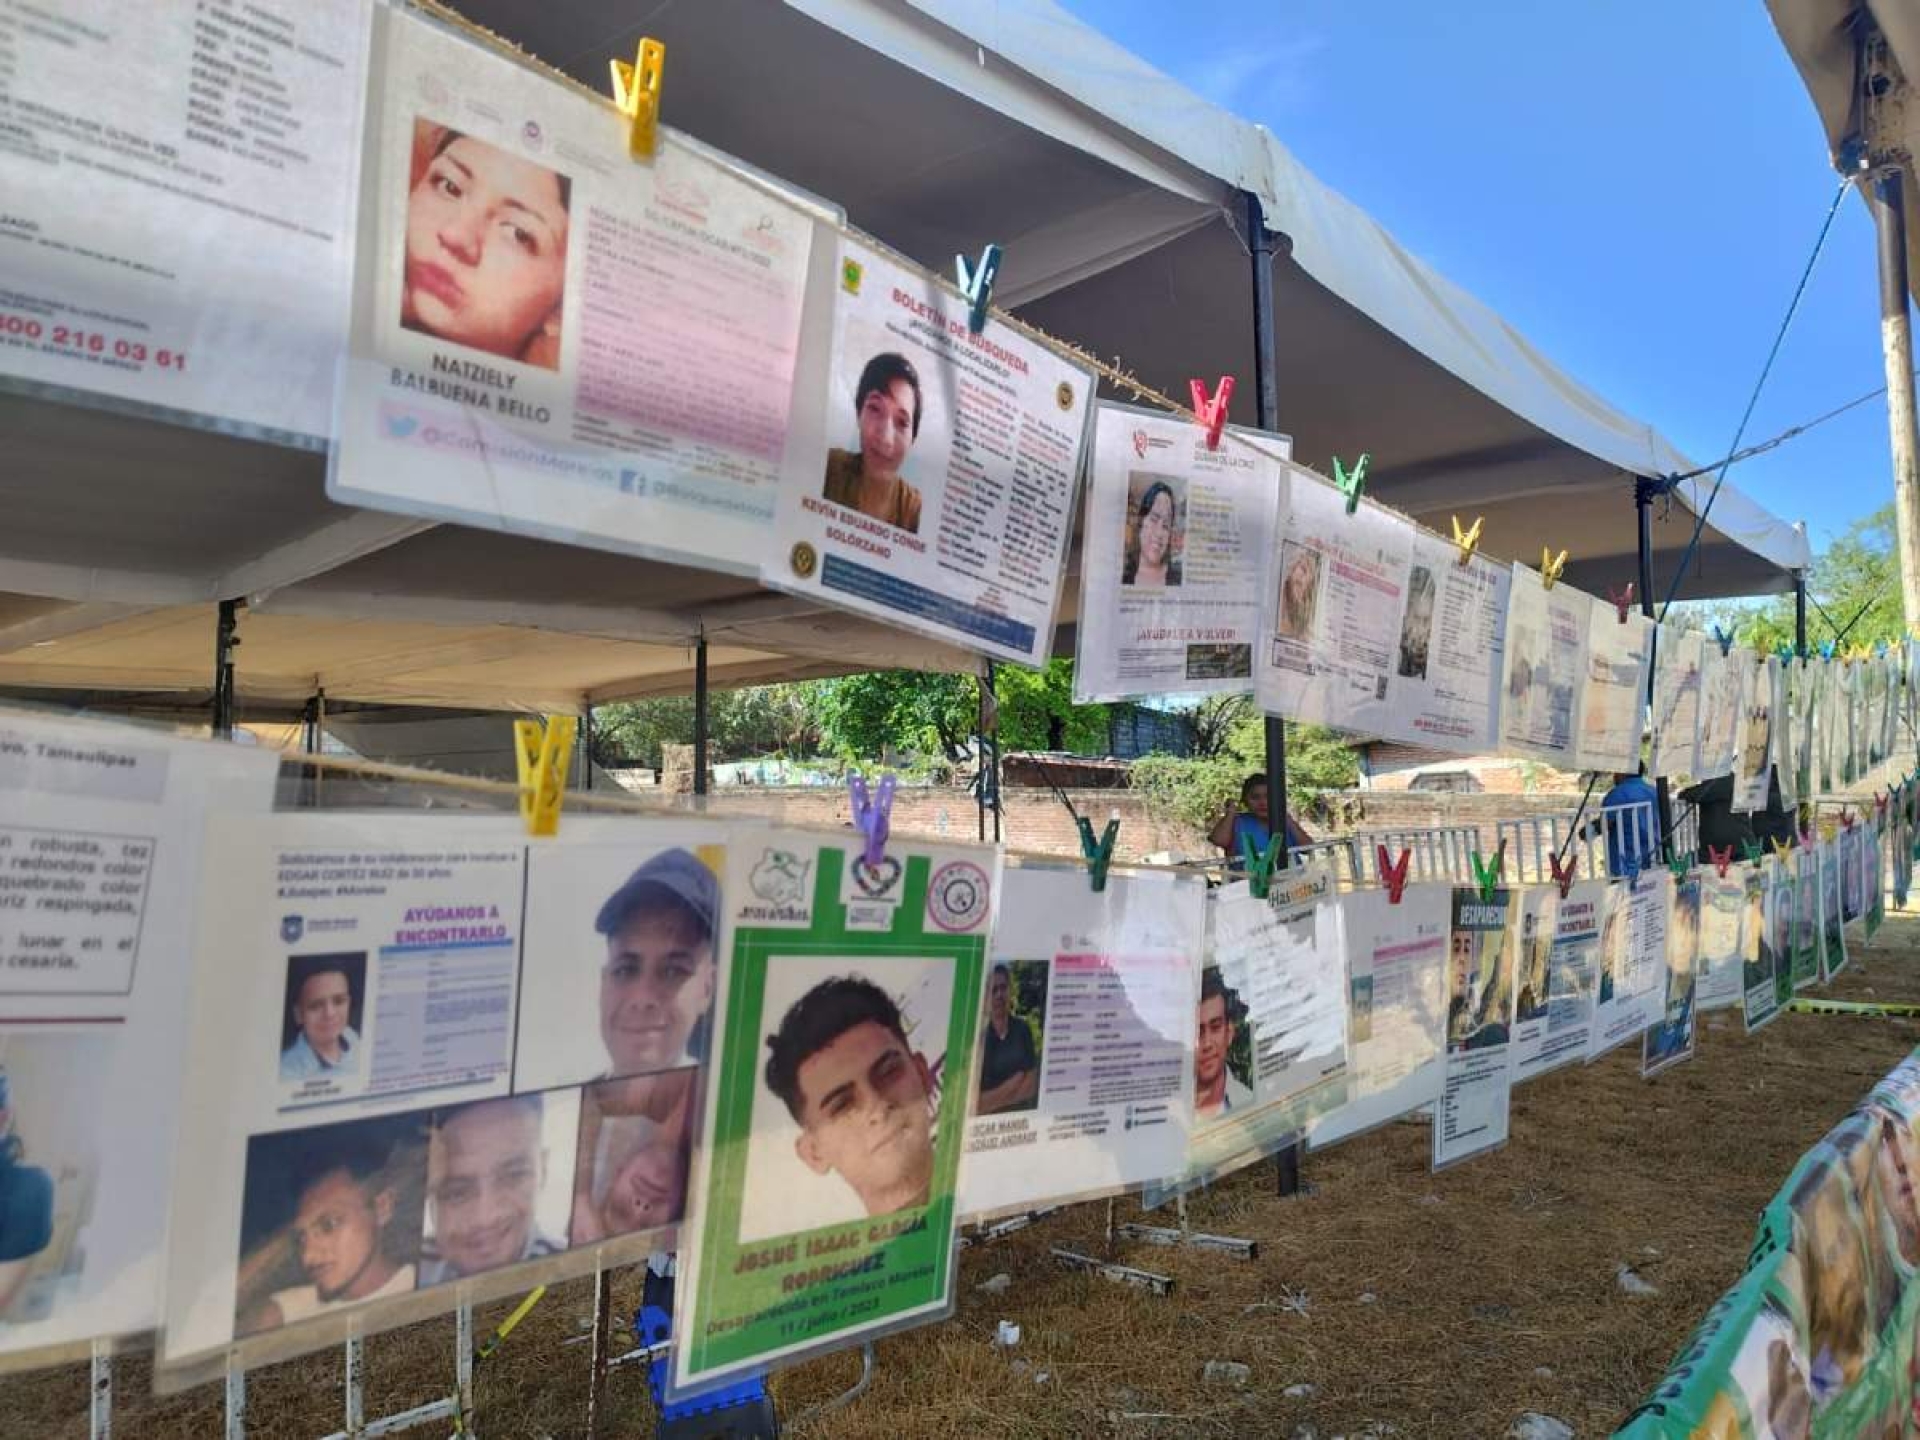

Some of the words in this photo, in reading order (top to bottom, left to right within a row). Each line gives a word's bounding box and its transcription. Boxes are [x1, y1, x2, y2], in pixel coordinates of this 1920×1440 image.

[949, 320, 966, 338] DE
[53, 325, 104, 353] 216
[114, 340, 147, 361] 03
[156, 349, 186, 371] 61
[431, 352, 516, 391] NATZIELY
[390, 367, 492, 411] BALBUENA
[497, 396, 551, 424] BELLO
[840, 511, 891, 540] EDUARDO
[892, 532, 927, 553] CONDE
[36, 743, 137, 768] Tamaulipas
[30, 837, 103, 857] robusta,
[122, 843, 148, 859] tez
[11, 855, 95, 874] redondos
[104, 861, 146, 876] color
[278, 868, 319, 883] EDGAR
[100, 879, 141, 896] color
[36, 896, 138, 915] respingada,
[18, 933, 65, 949] lunar
[81, 937, 103, 950] en
[117, 937, 133, 951] el
[396, 925, 507, 944] ENCONTRARLO
[733, 1234, 799, 1275] JOSUÉ
[806, 1230, 861, 1257] ISAAC
[867, 1211, 928, 1243] GARCÍA
[706, 1298, 809, 1337] Desaparecido
[811, 1294, 830, 1307] en
